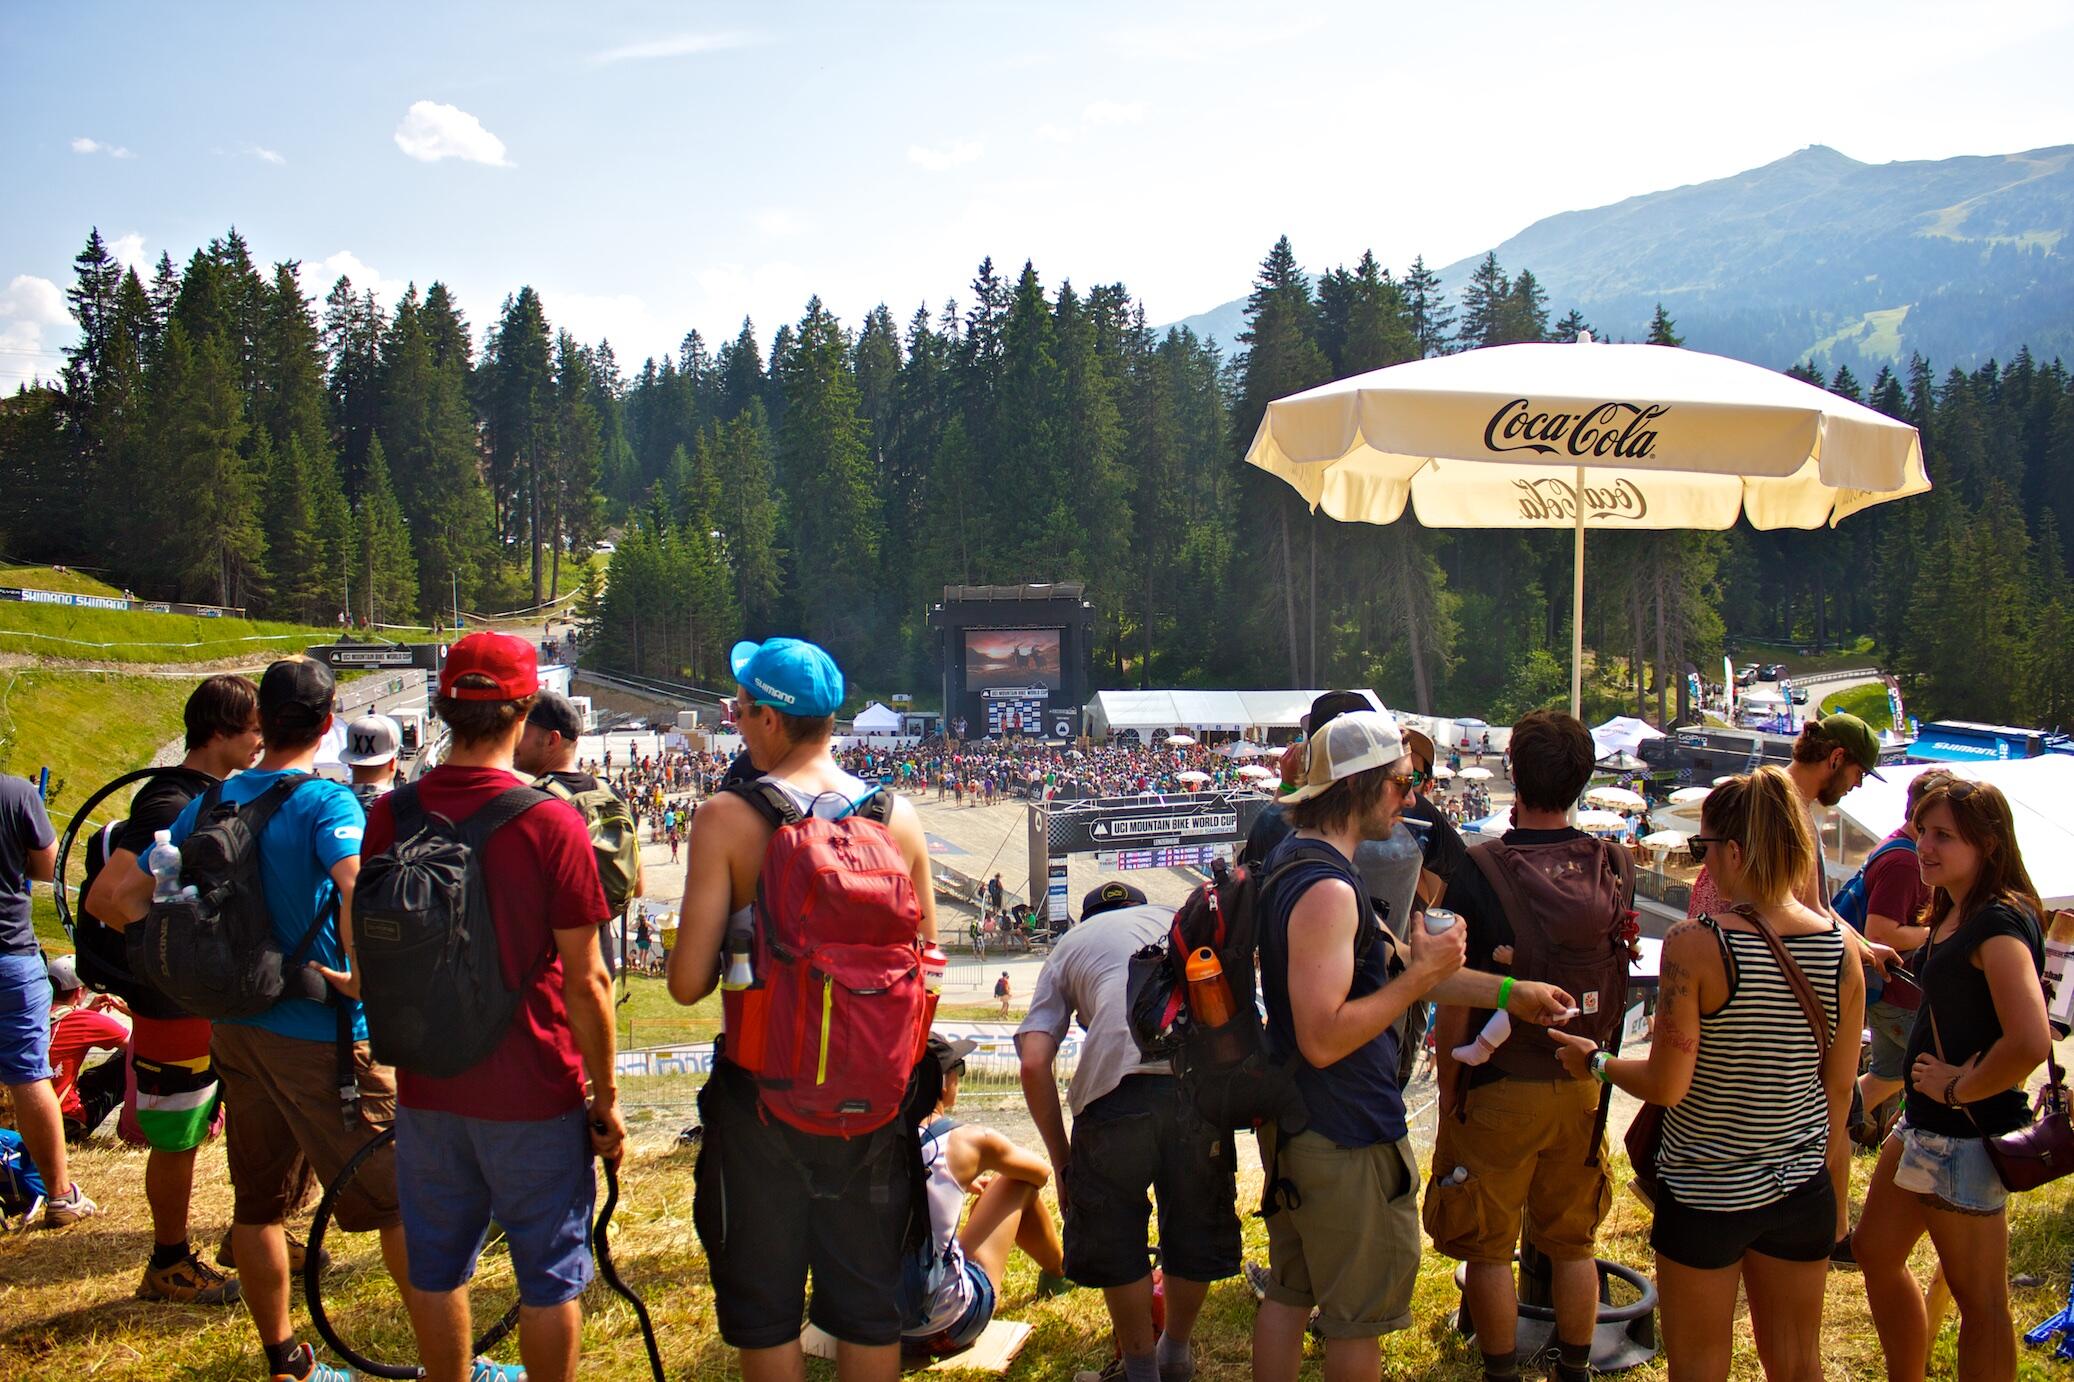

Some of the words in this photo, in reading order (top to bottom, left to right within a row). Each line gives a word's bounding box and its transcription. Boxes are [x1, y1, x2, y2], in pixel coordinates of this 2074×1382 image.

[1484, 398, 1672, 459] Coca-Cola
[21, 590, 73, 605] SHIMANO
[75, 596, 128, 610] SHIMANO
[754, 677, 796, 704] SHIMANO
[353, 733, 376, 754] XX
[1114, 822, 1128, 834] UCI
[1129, 819, 1170, 833] MOUNTAIN
[1172, 818, 1190, 830] BIKE
[1192, 816, 1219, 829] WORLD
[1220, 815, 1236, 827] CUP
